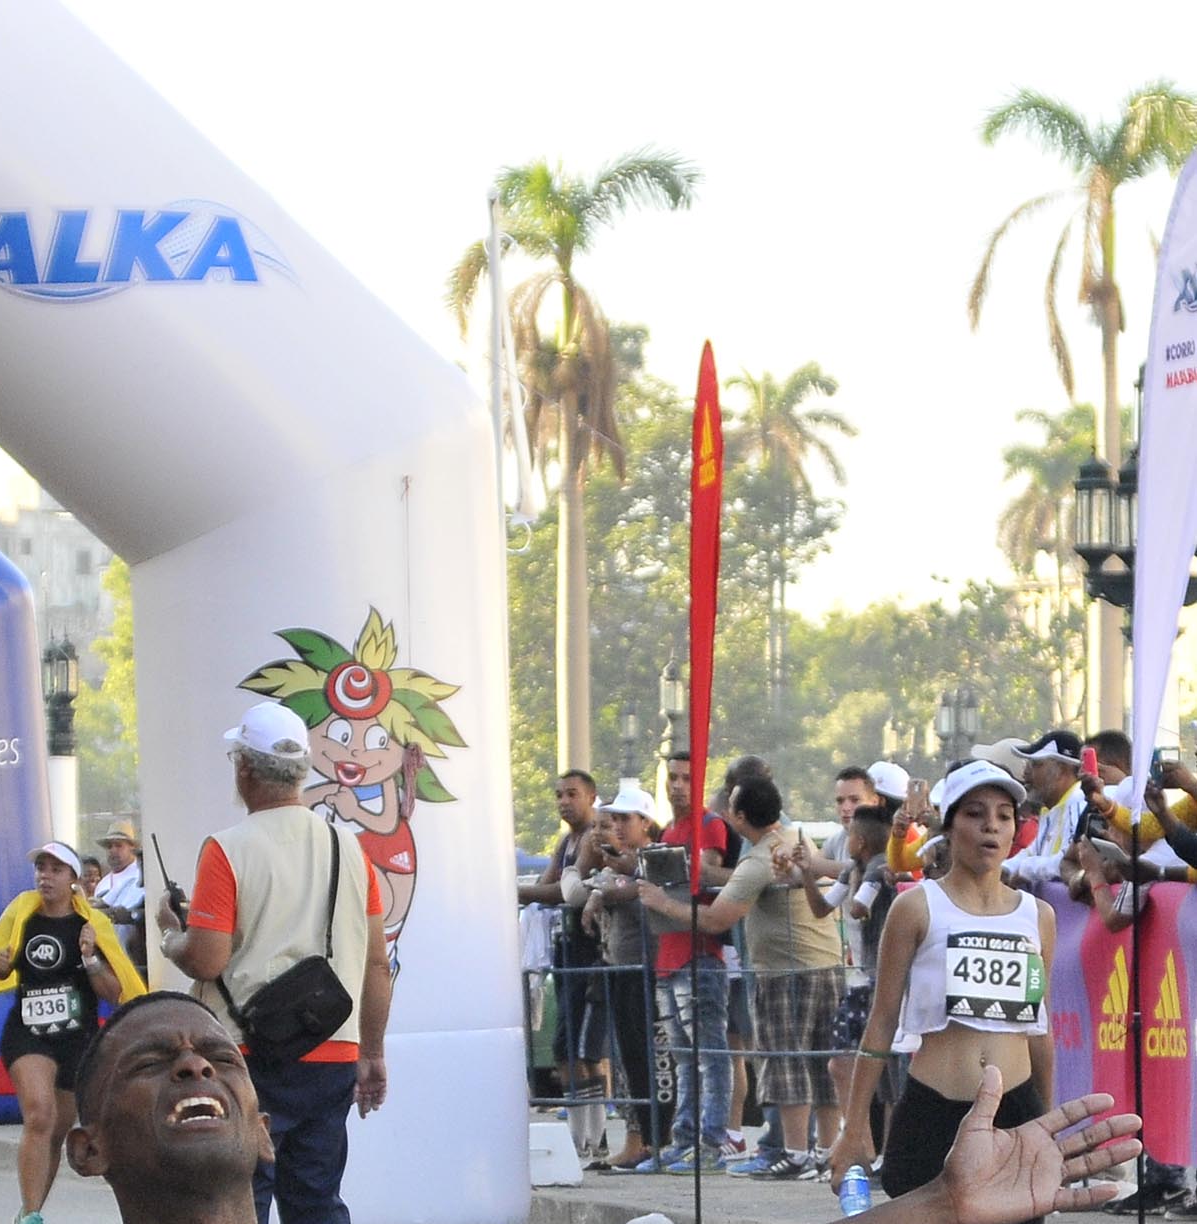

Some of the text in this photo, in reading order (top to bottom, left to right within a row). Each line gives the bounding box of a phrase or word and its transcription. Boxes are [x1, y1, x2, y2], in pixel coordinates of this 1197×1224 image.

[958, 936, 987, 948] XXXI
[953, 956, 1022, 988] 4382
[1030, 968, 1040, 989] 10K
[26, 998, 66, 1017] 1336
